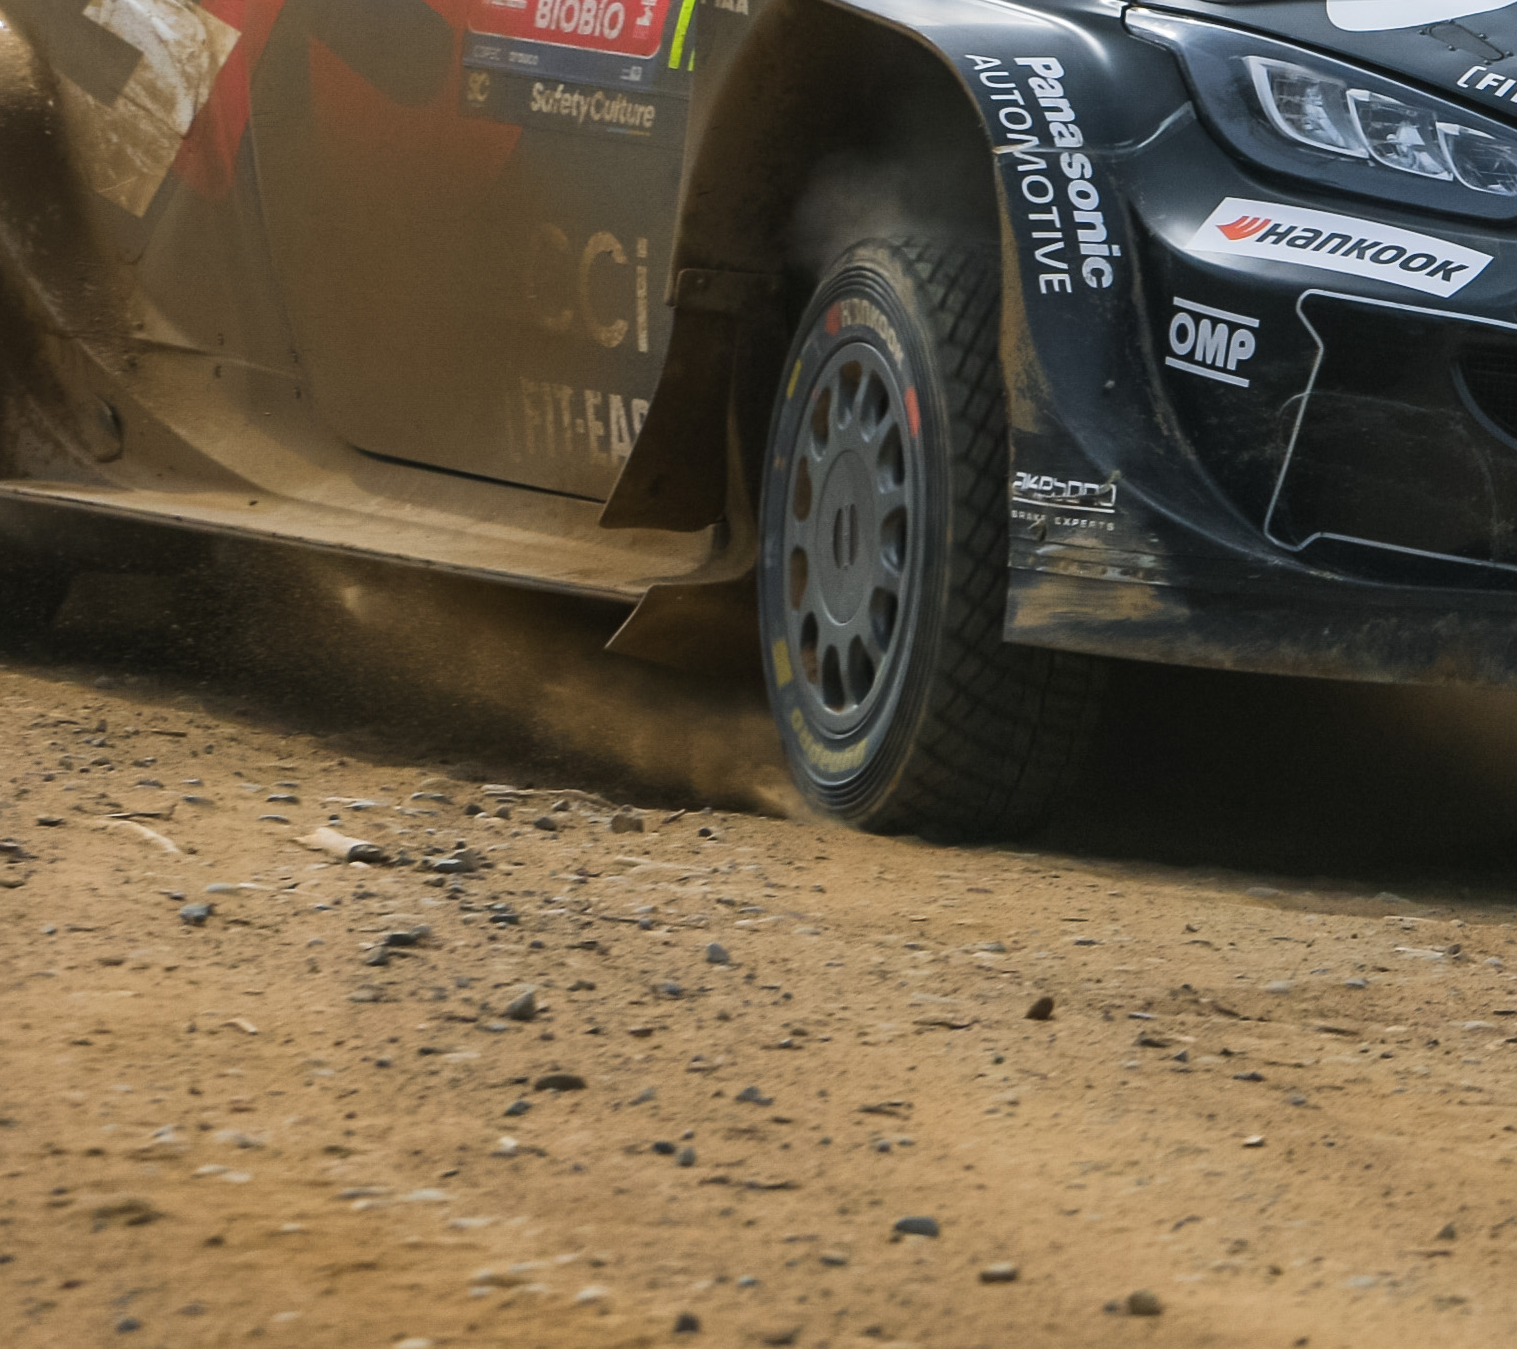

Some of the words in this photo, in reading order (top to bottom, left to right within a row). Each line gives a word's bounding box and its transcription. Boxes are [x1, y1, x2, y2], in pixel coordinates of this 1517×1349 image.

[964, 53, 1073, 295] AUTOMOTIVE
[1013, 56, 1122, 289] Panasonic
[1167, 311, 1257, 372] OMP
